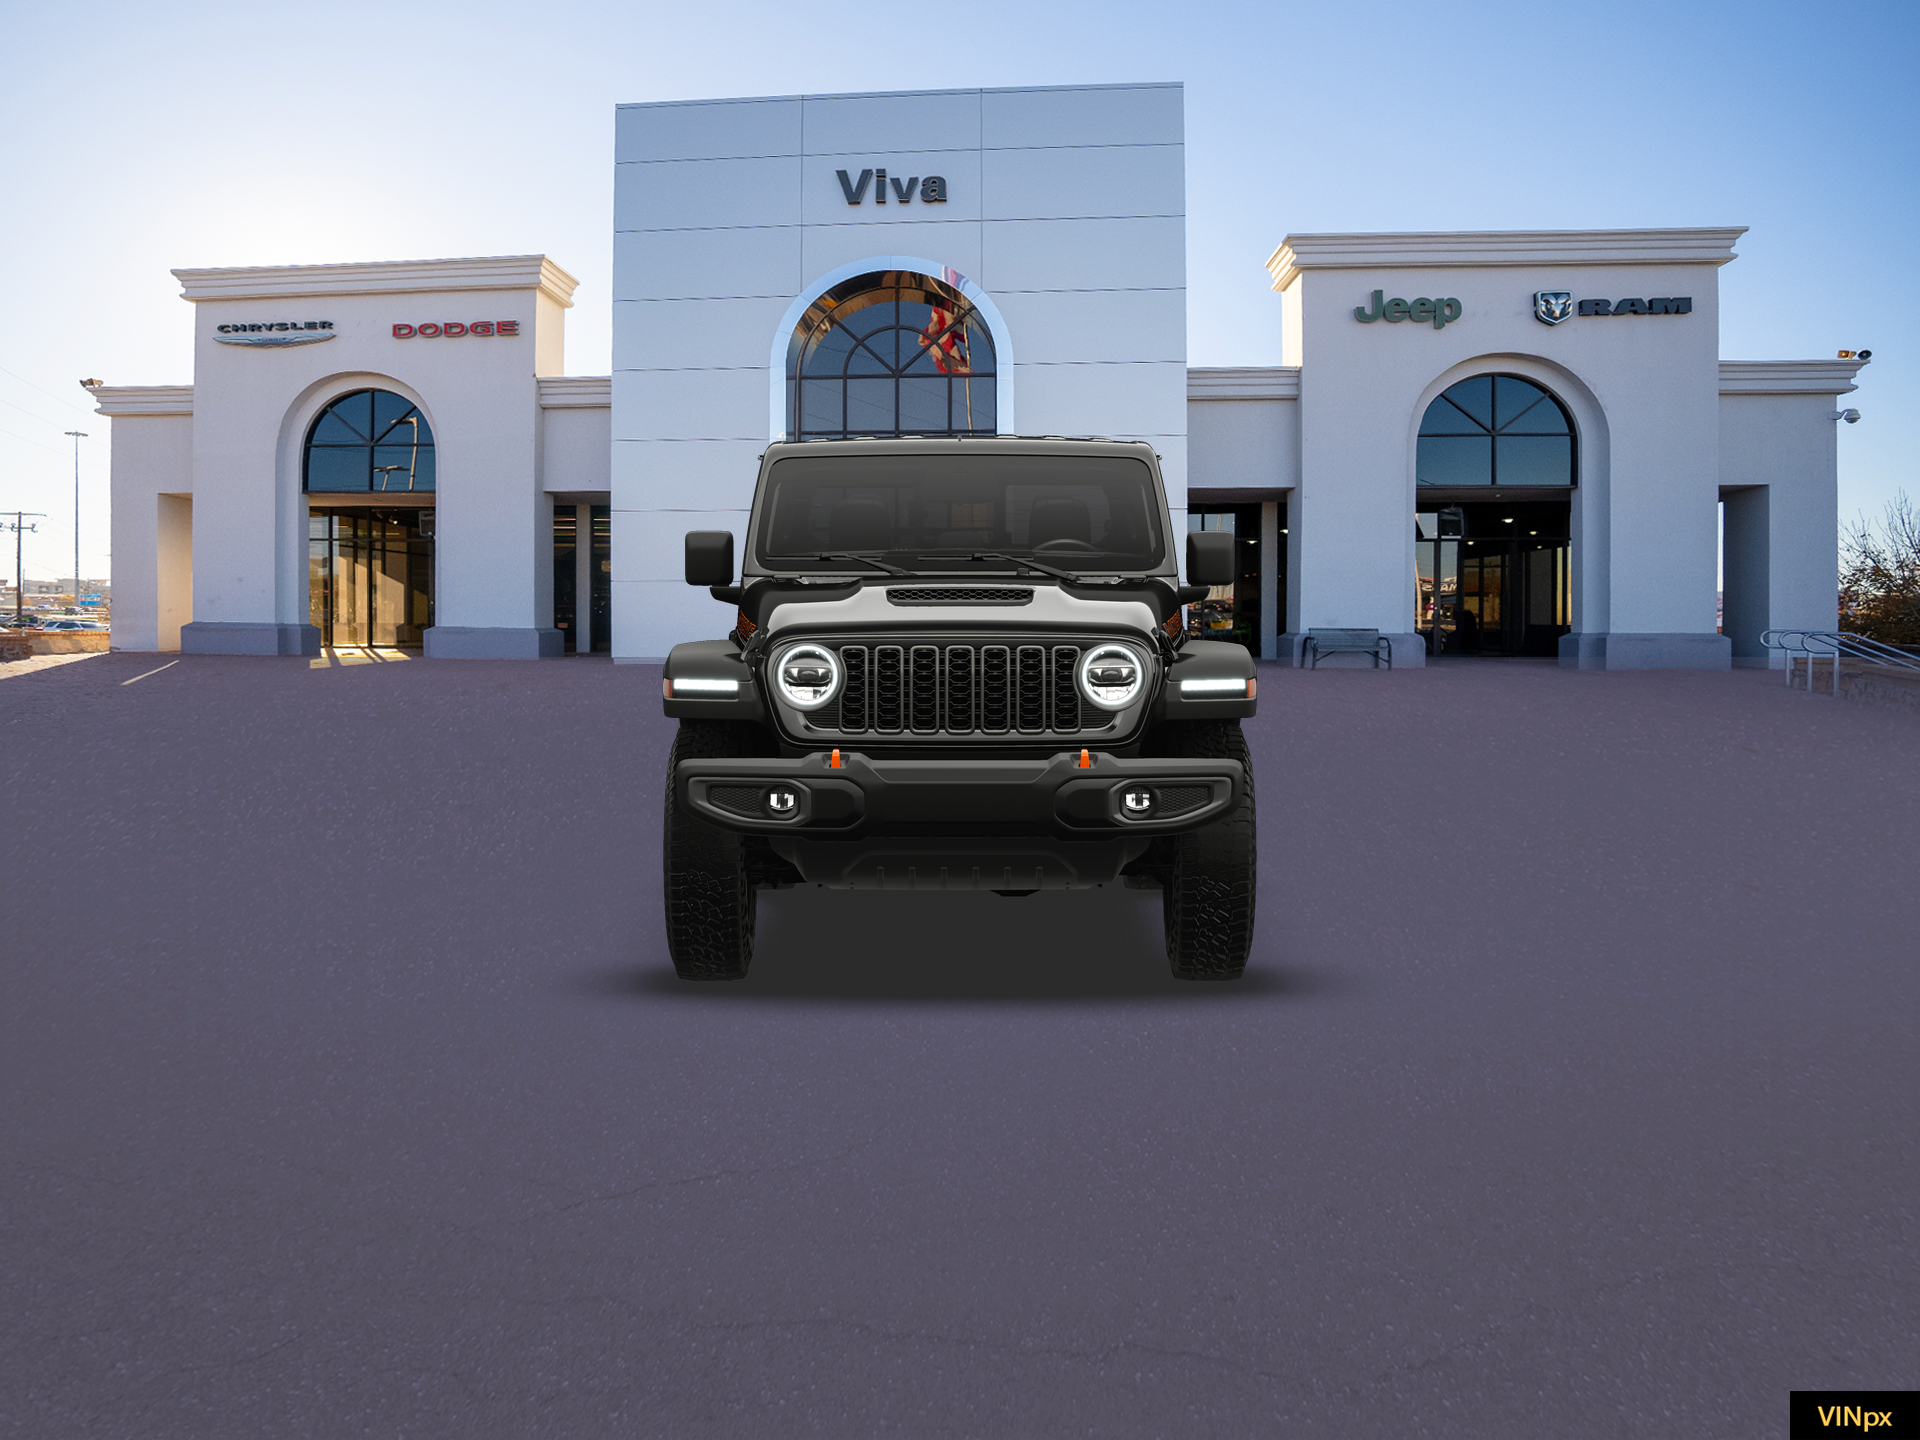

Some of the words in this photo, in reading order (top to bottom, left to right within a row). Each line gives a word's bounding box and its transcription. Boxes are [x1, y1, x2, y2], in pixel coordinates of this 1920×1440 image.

[835, 168, 947, 205] Viva
[1354, 289, 1463, 329] Jeep
[1578, 296, 1692, 316] RAM
[217, 320, 334, 334] CHRYSLER
[392, 320, 520, 339] DODGE
